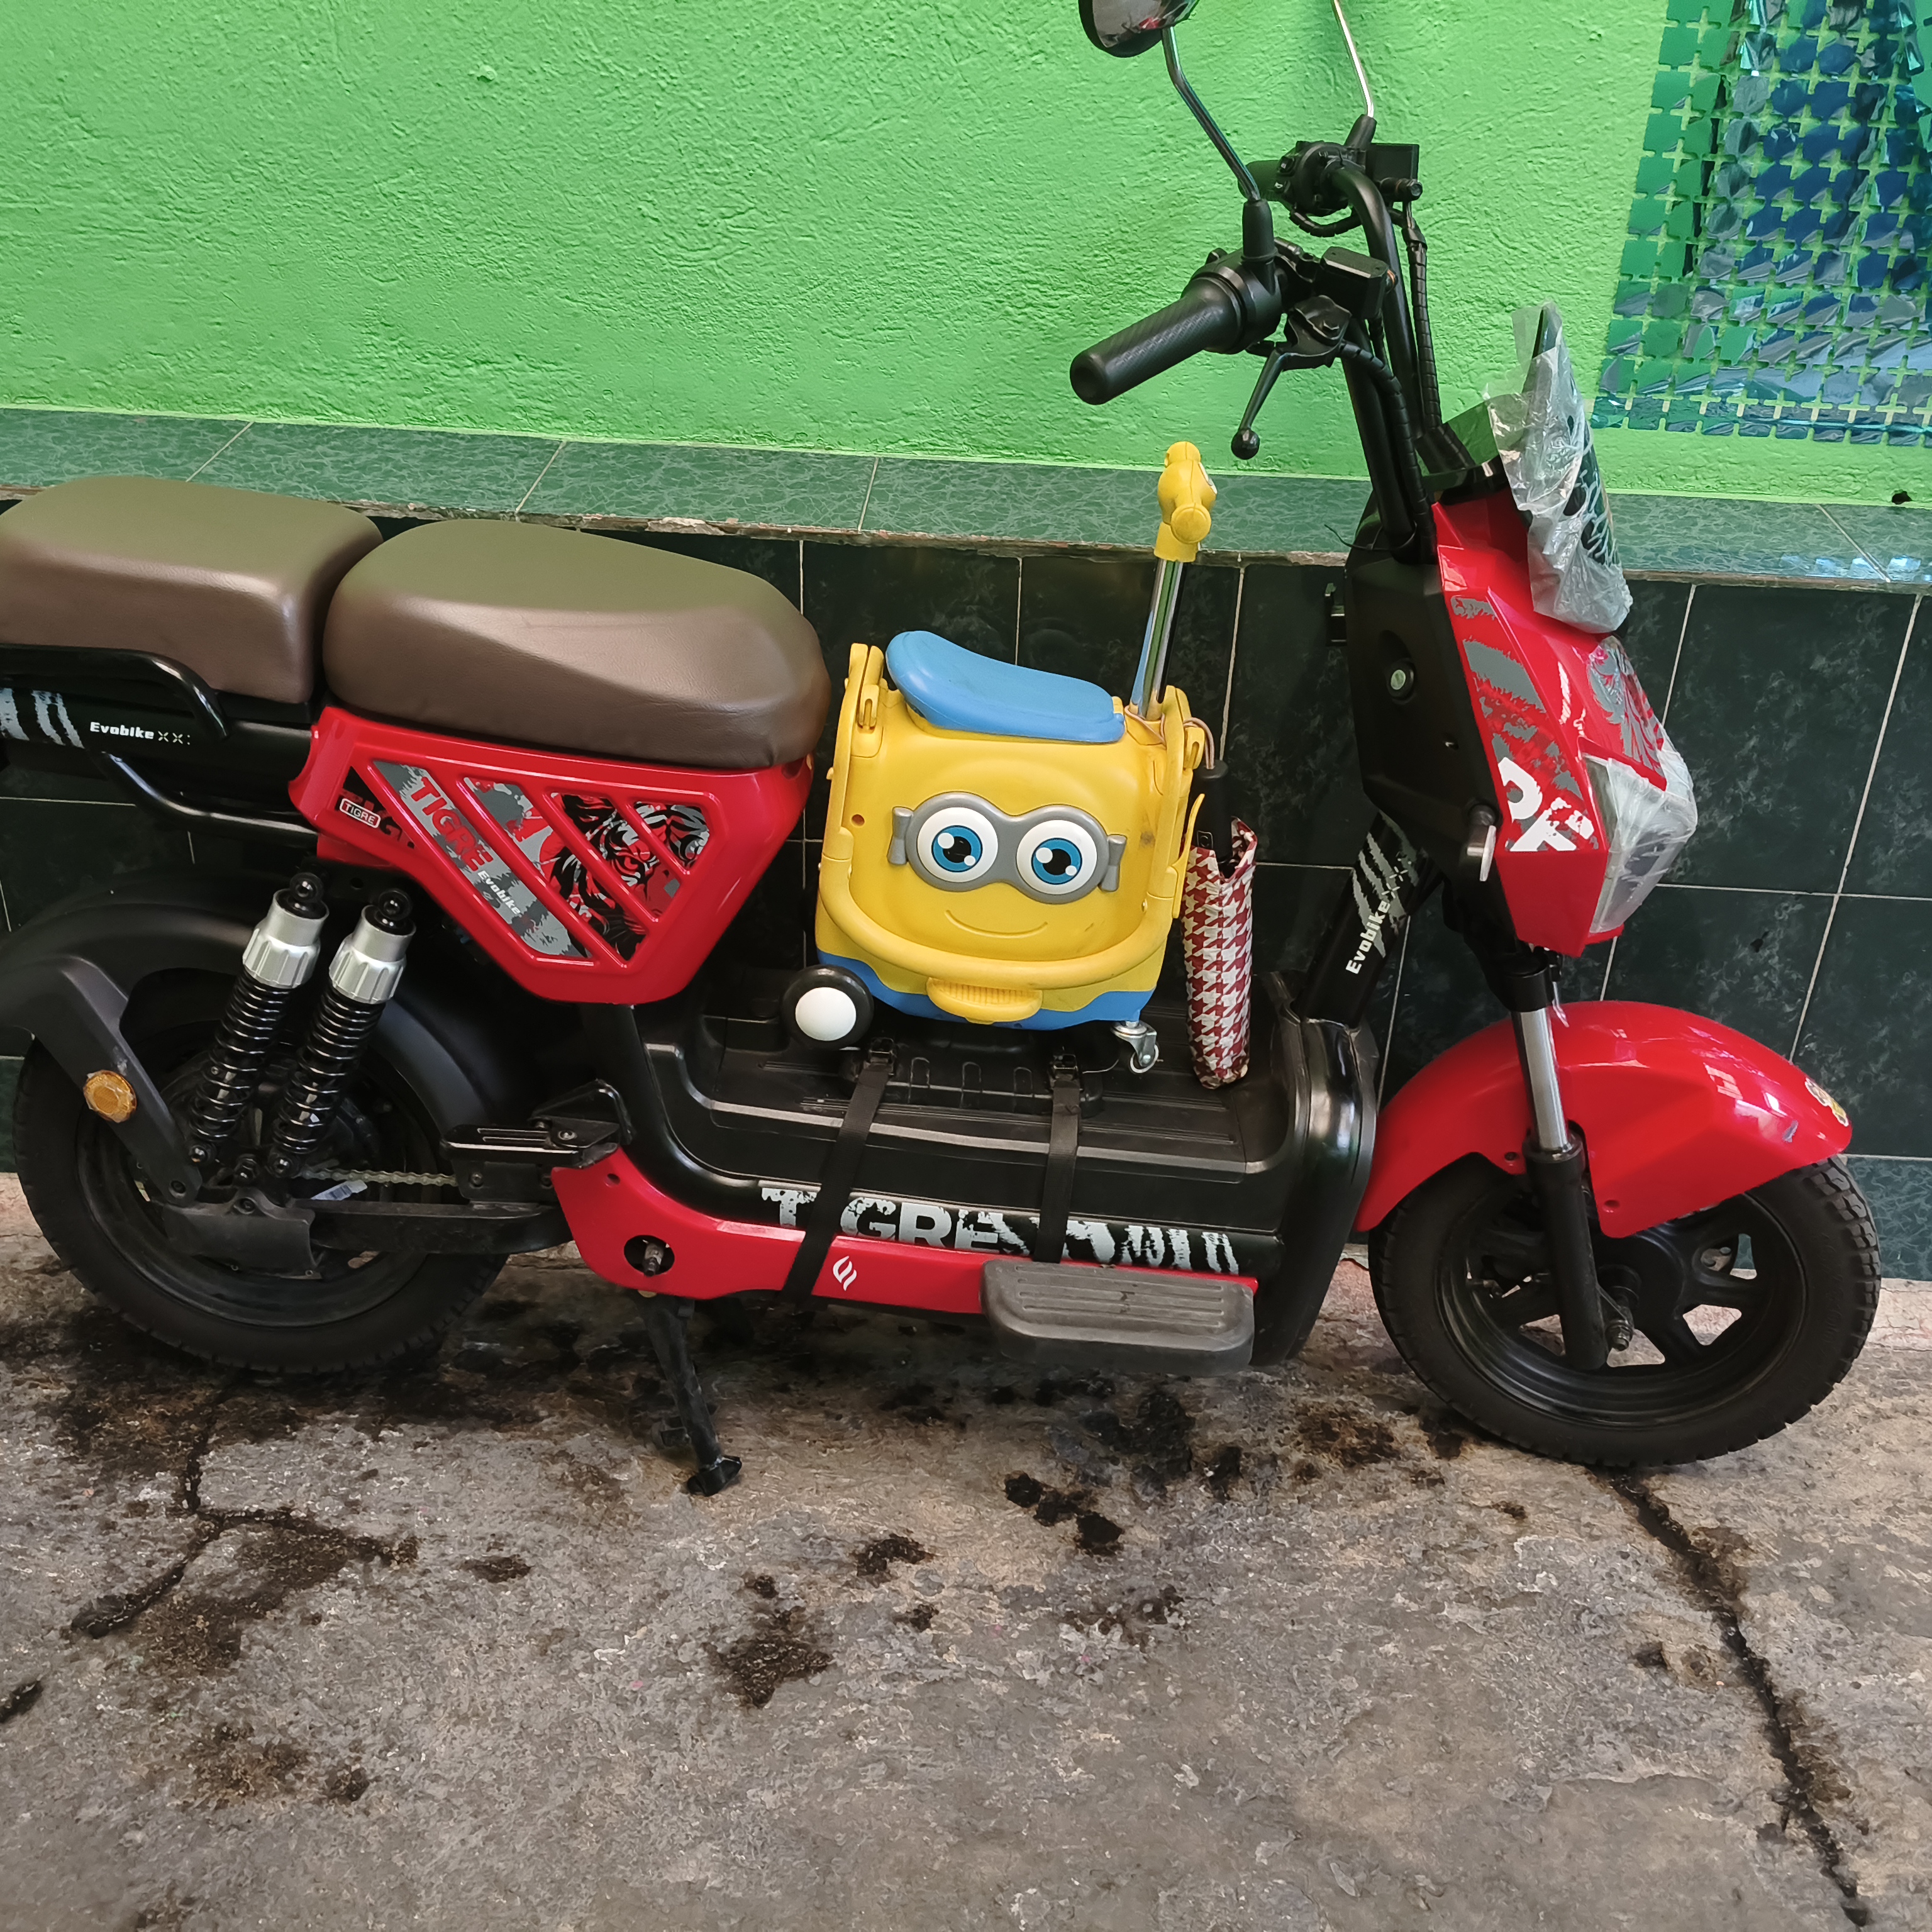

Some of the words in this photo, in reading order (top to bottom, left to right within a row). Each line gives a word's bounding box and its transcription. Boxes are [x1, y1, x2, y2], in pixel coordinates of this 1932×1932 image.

[90, 721, 155, 740] Evobike
[345, 802, 376, 825] TIGRE
[411, 776, 494, 872] TIGRE
[477, 870, 521, 915] Evobike
[1345, 900, 1391, 974] Evobike
[761, 1187, 1004, 1253] TGRE
